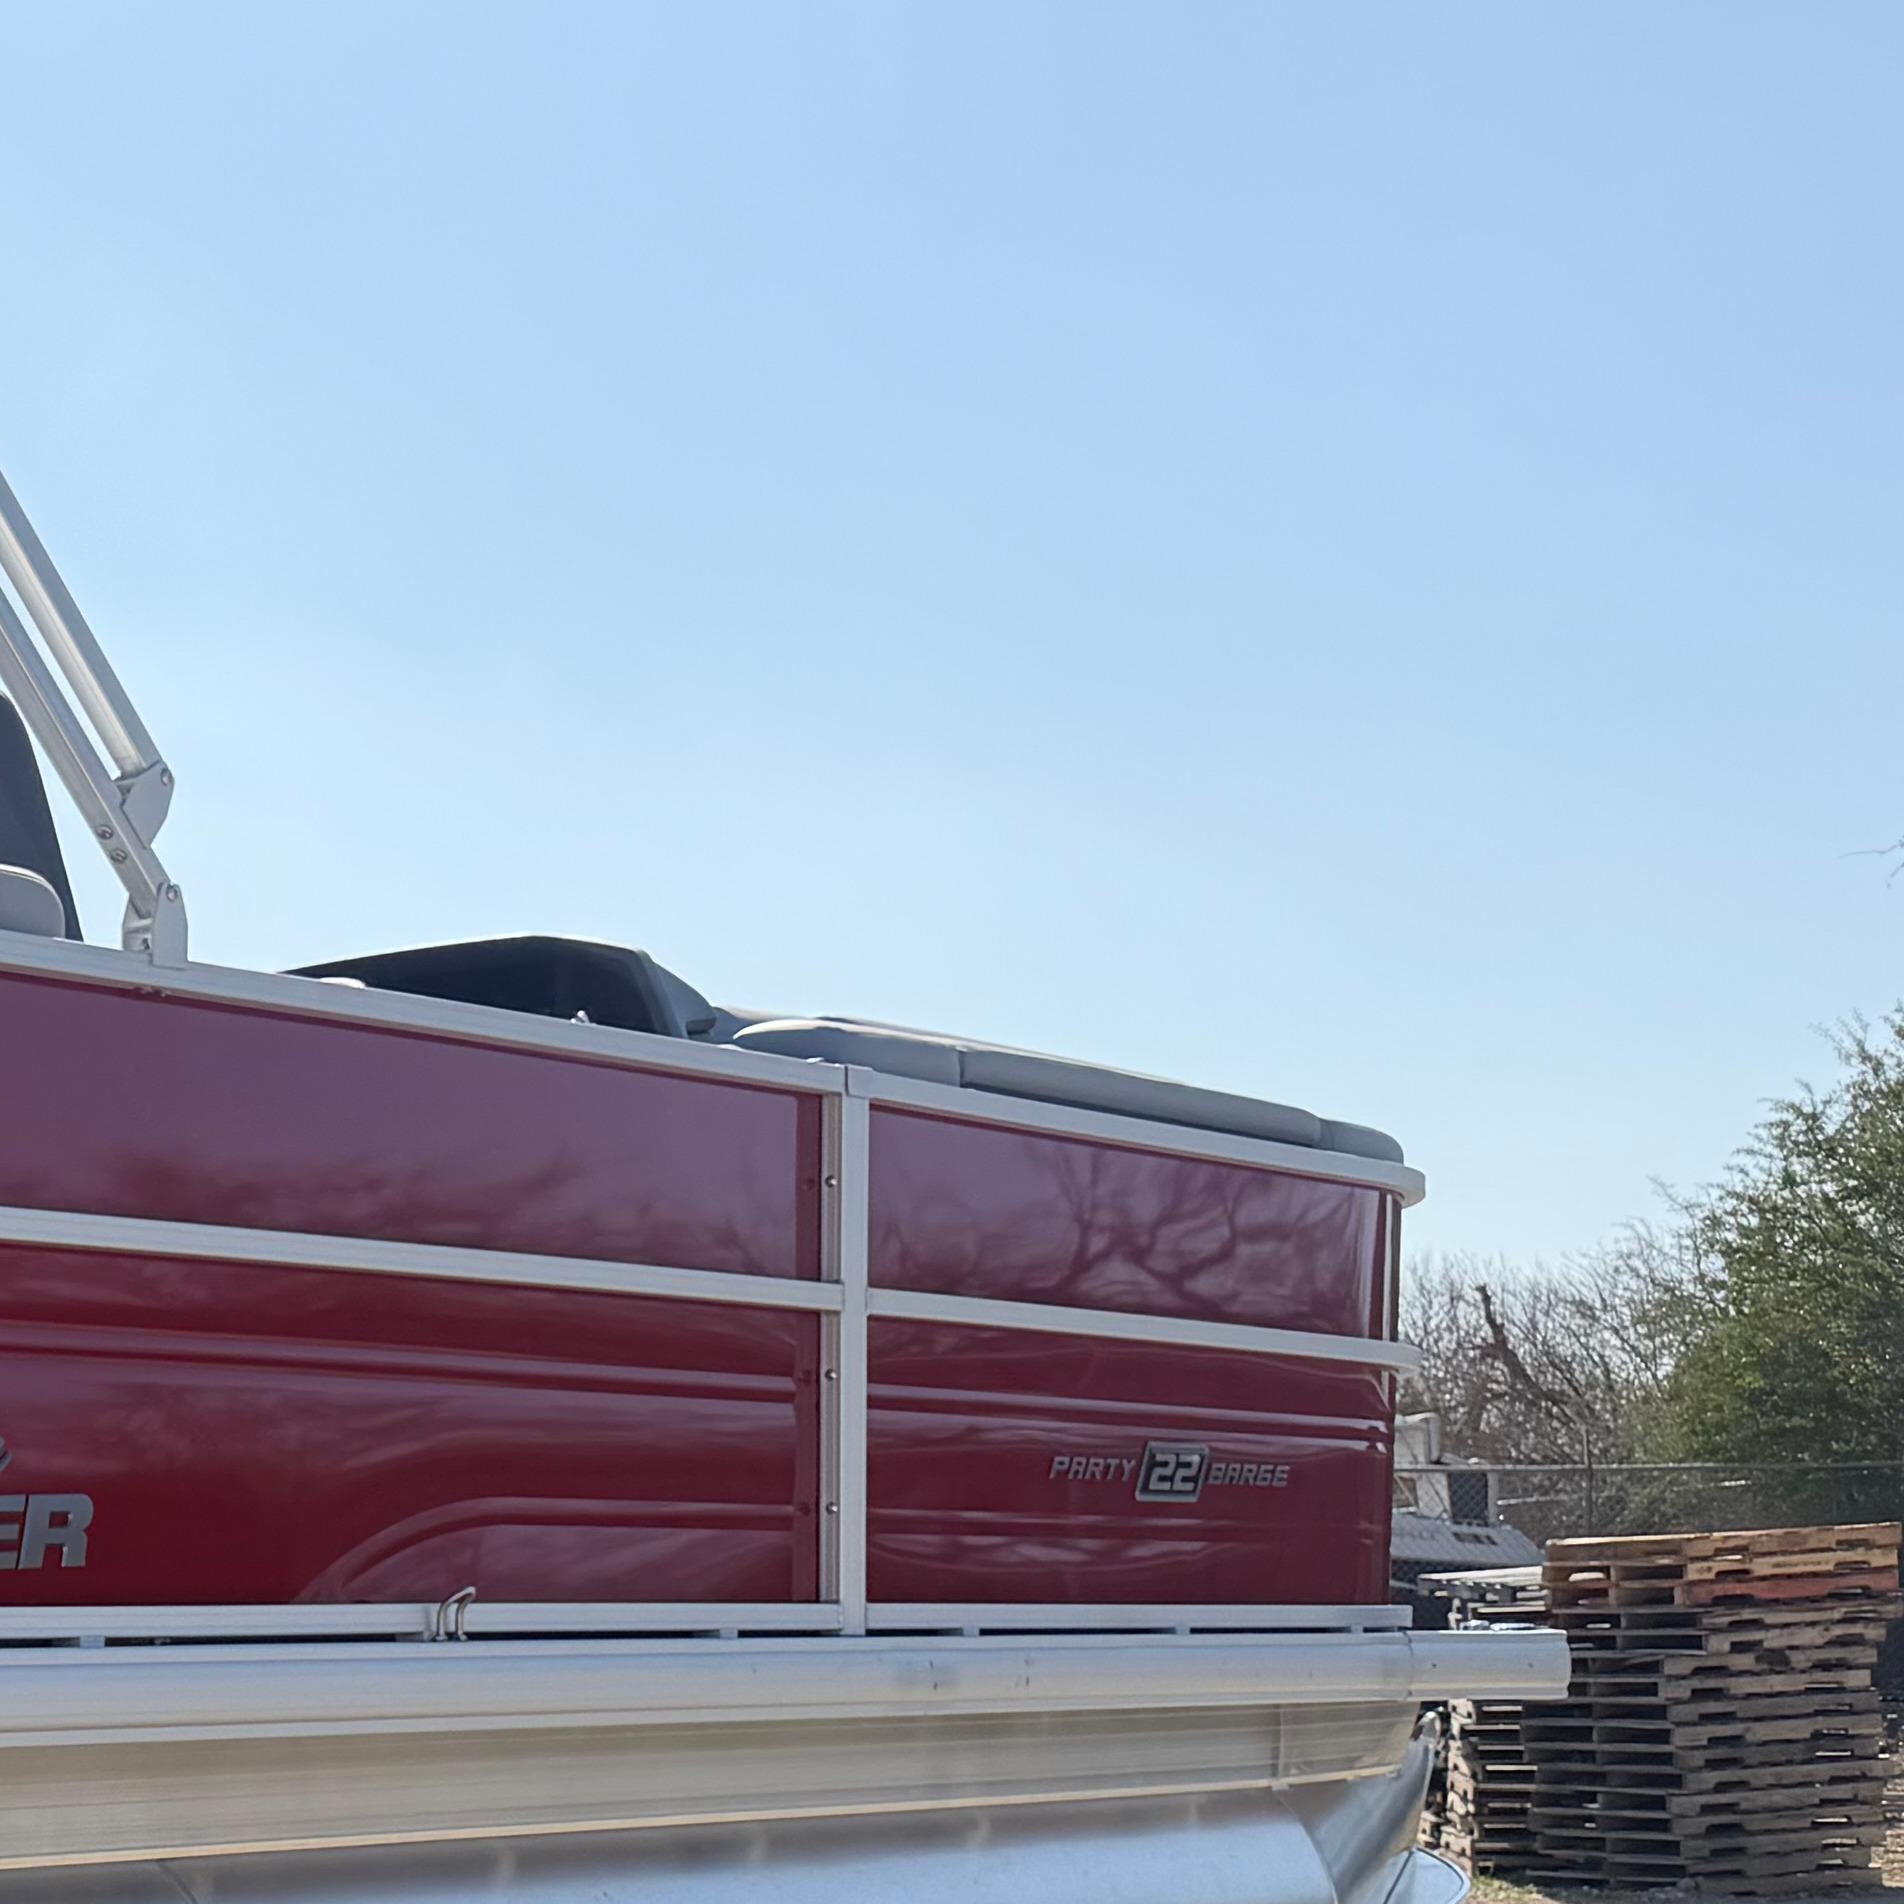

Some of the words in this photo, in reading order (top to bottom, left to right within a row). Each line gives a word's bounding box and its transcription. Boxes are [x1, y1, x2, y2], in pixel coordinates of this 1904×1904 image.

[1051, 1456, 1136, 1481] PARTY
[1149, 1453, 1201, 1491] 22
[1208, 1463, 1291, 1487] BARGE
